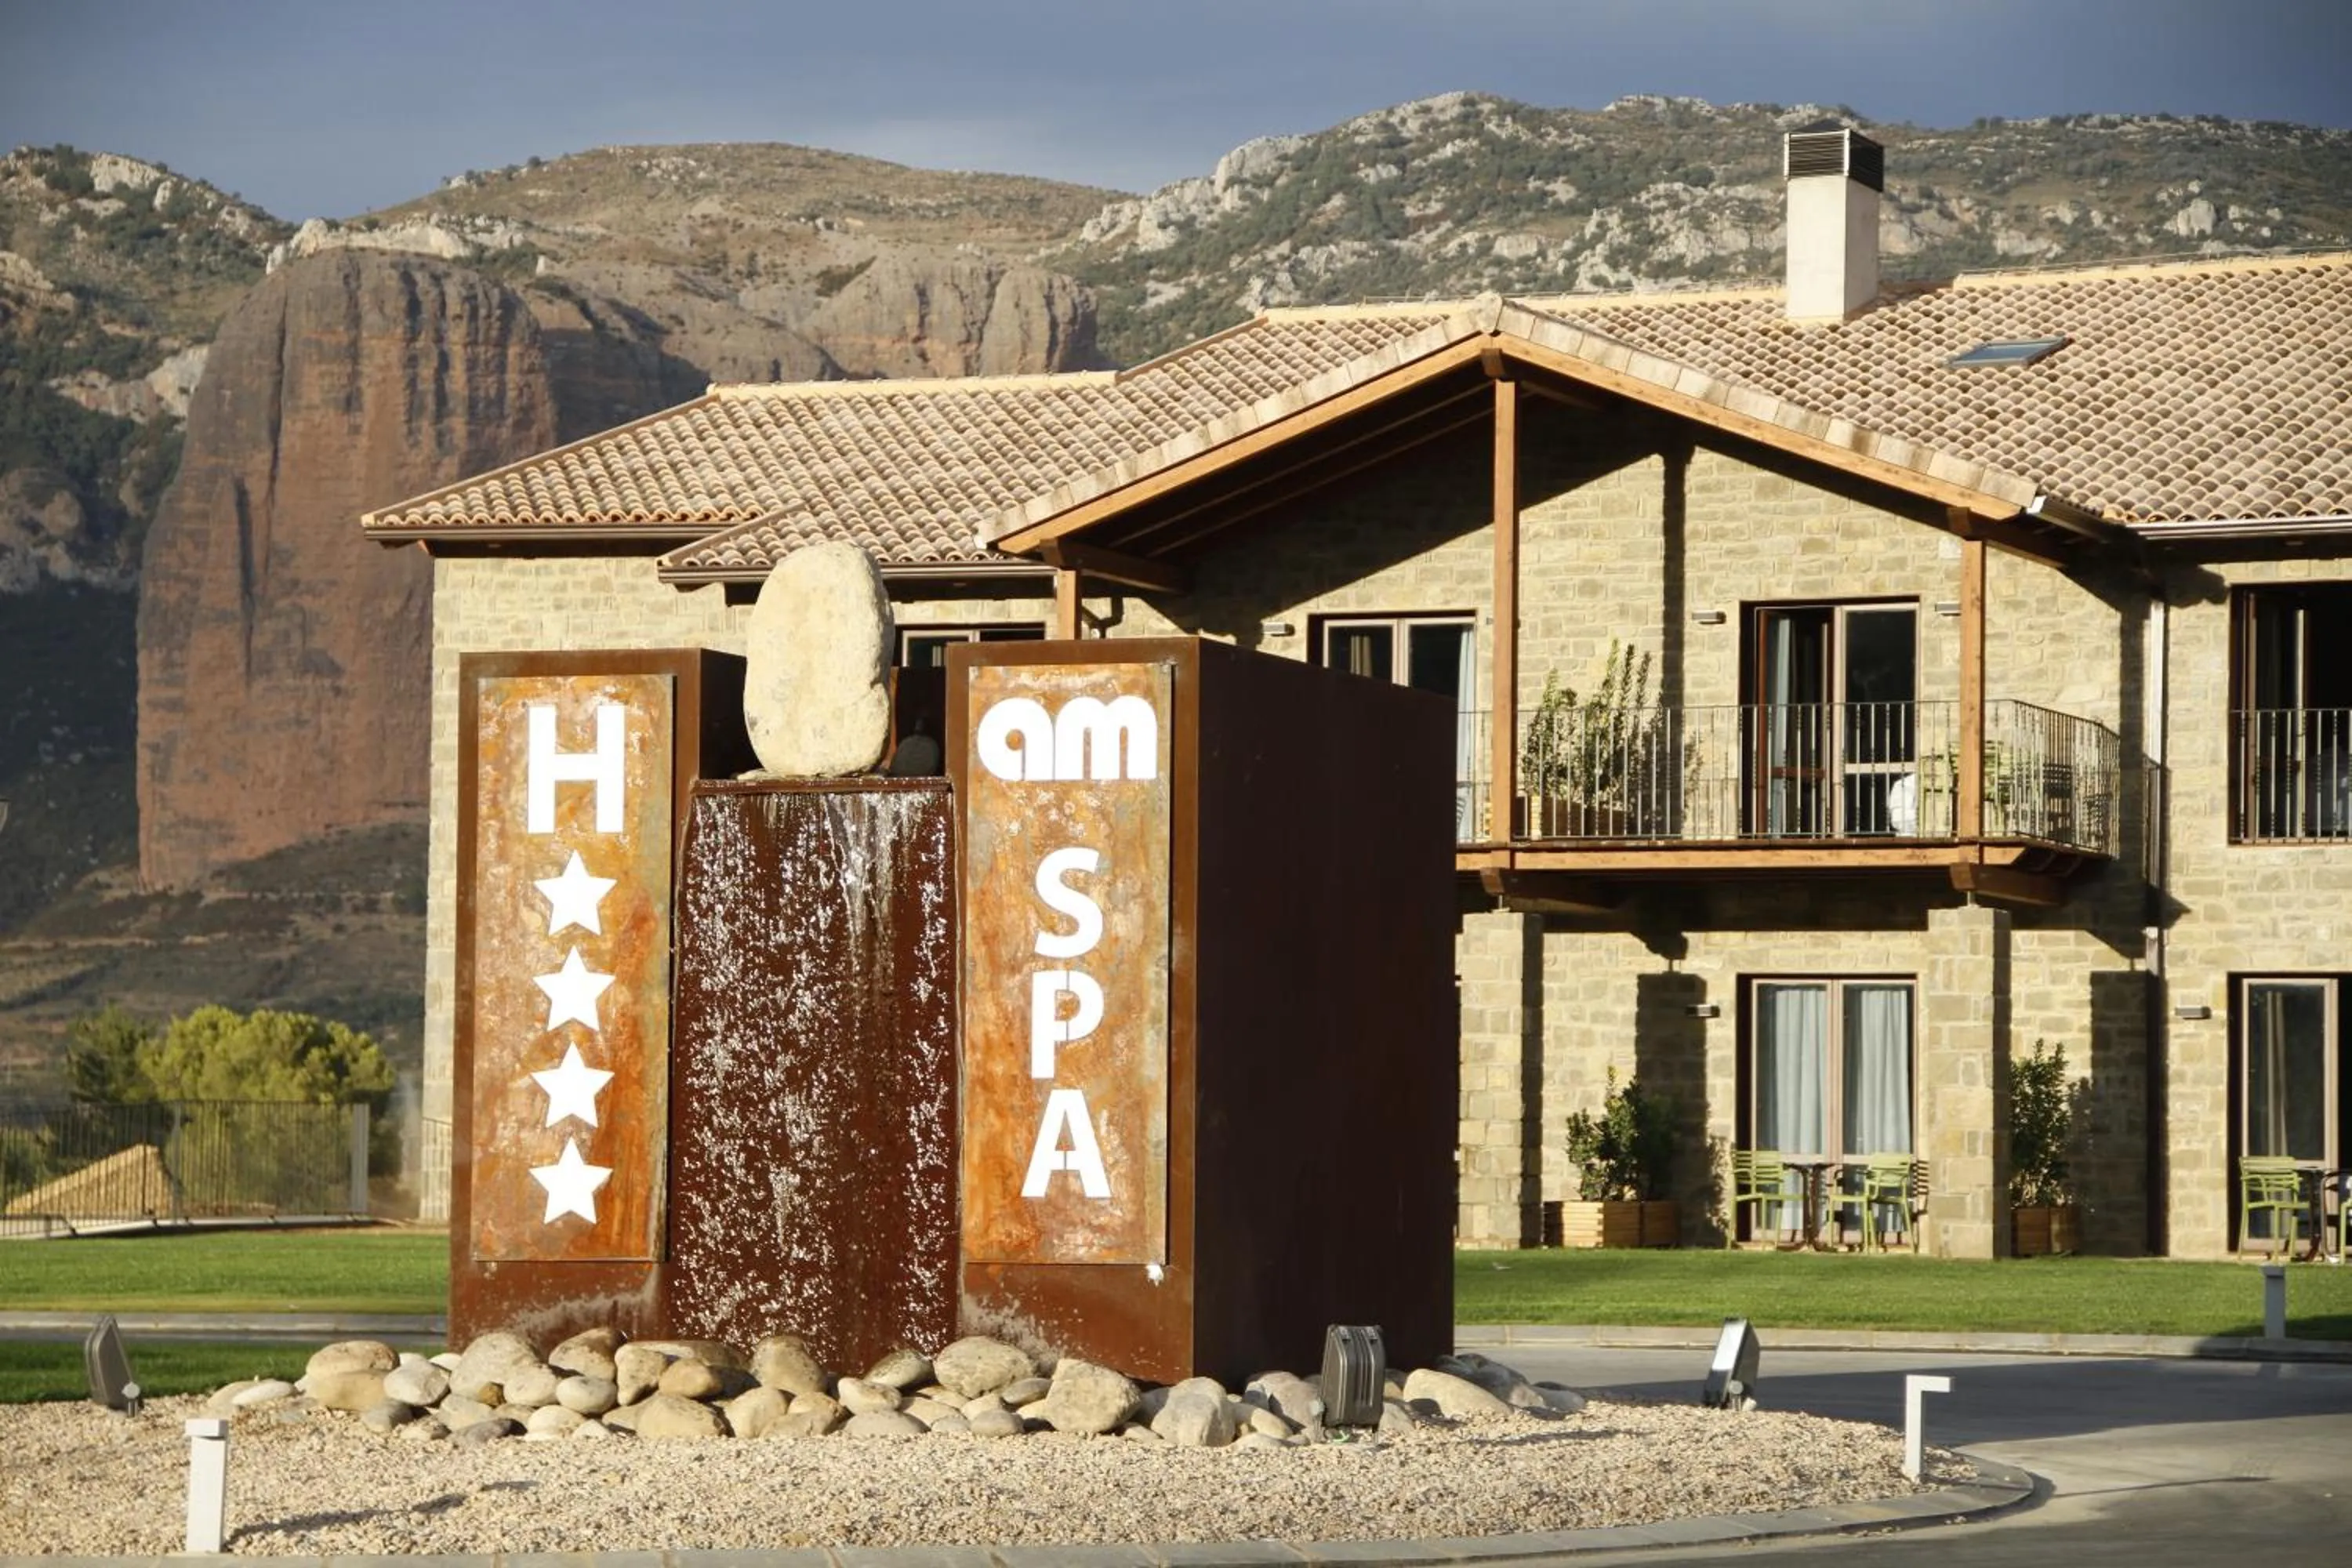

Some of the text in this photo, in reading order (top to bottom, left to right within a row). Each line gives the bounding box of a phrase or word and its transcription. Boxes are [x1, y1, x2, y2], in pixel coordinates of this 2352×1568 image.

[527, 704, 626, 834] H
[977, 695, 1159, 782] am
[1021, 847, 1112, 1199] SPA
